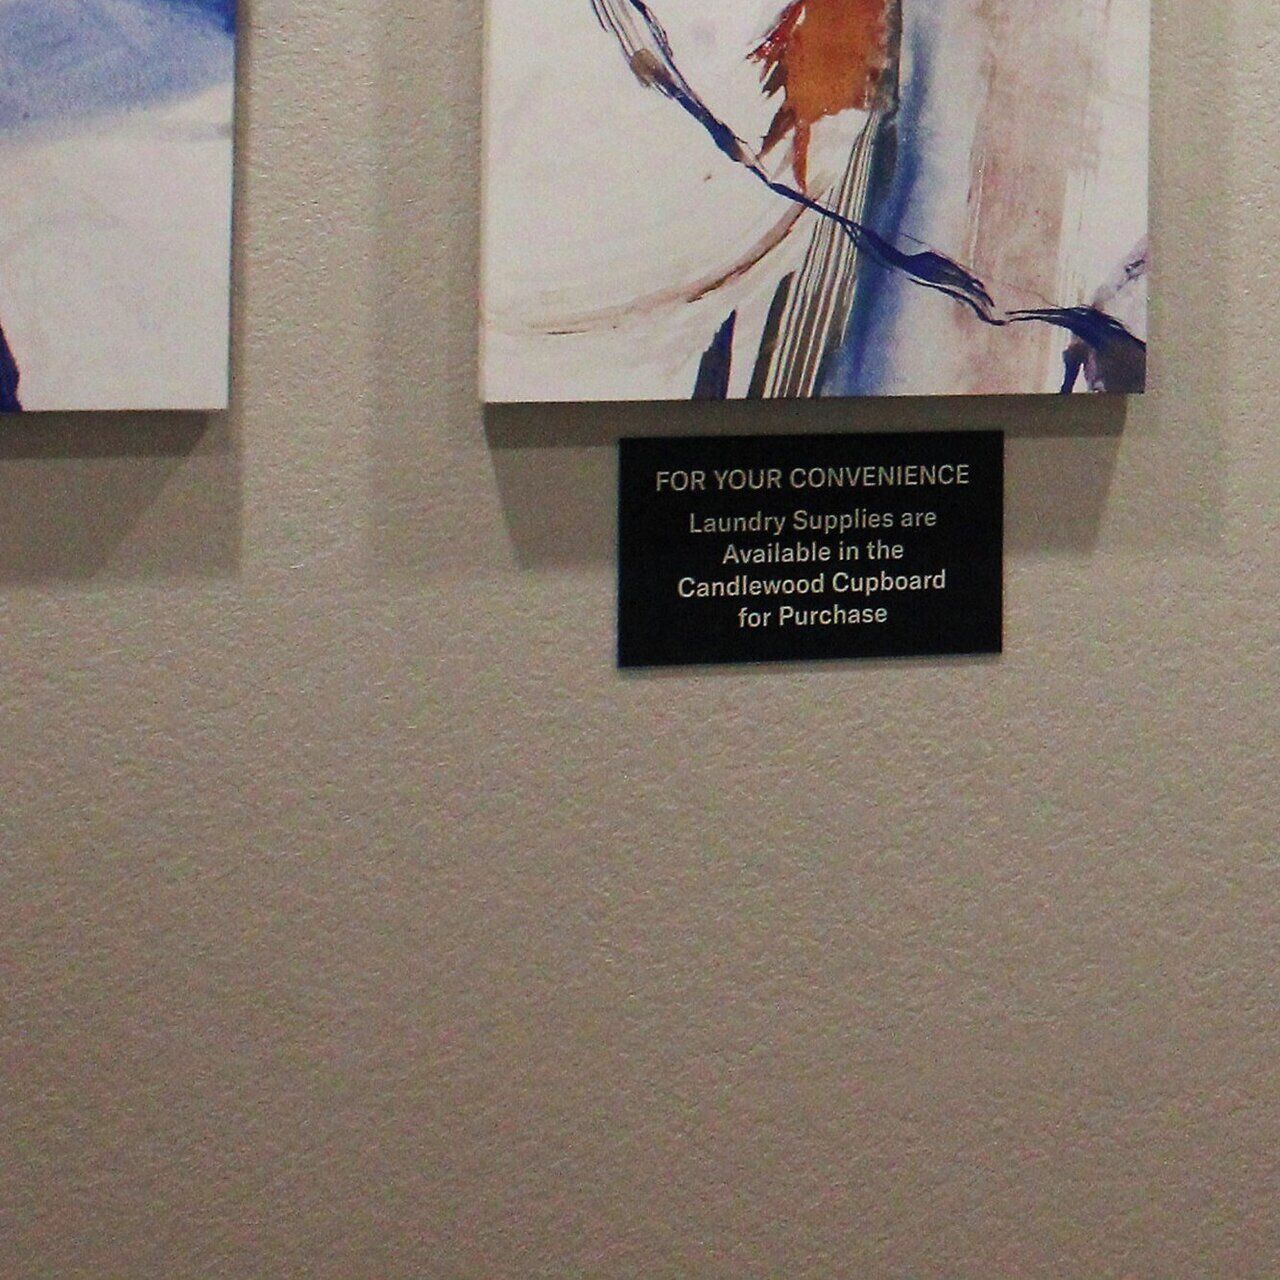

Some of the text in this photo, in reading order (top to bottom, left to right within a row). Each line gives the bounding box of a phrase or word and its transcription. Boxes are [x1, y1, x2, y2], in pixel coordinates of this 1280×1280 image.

[656, 463, 970, 492] FOR YOUR CONVENIENCE
[689, 507, 937, 536] Laundry Supplies are
[721, 539, 905, 565] Available in the
[677, 568, 946, 599] Candlewood Cupboard
[737, 603, 888, 629] for Purchase
